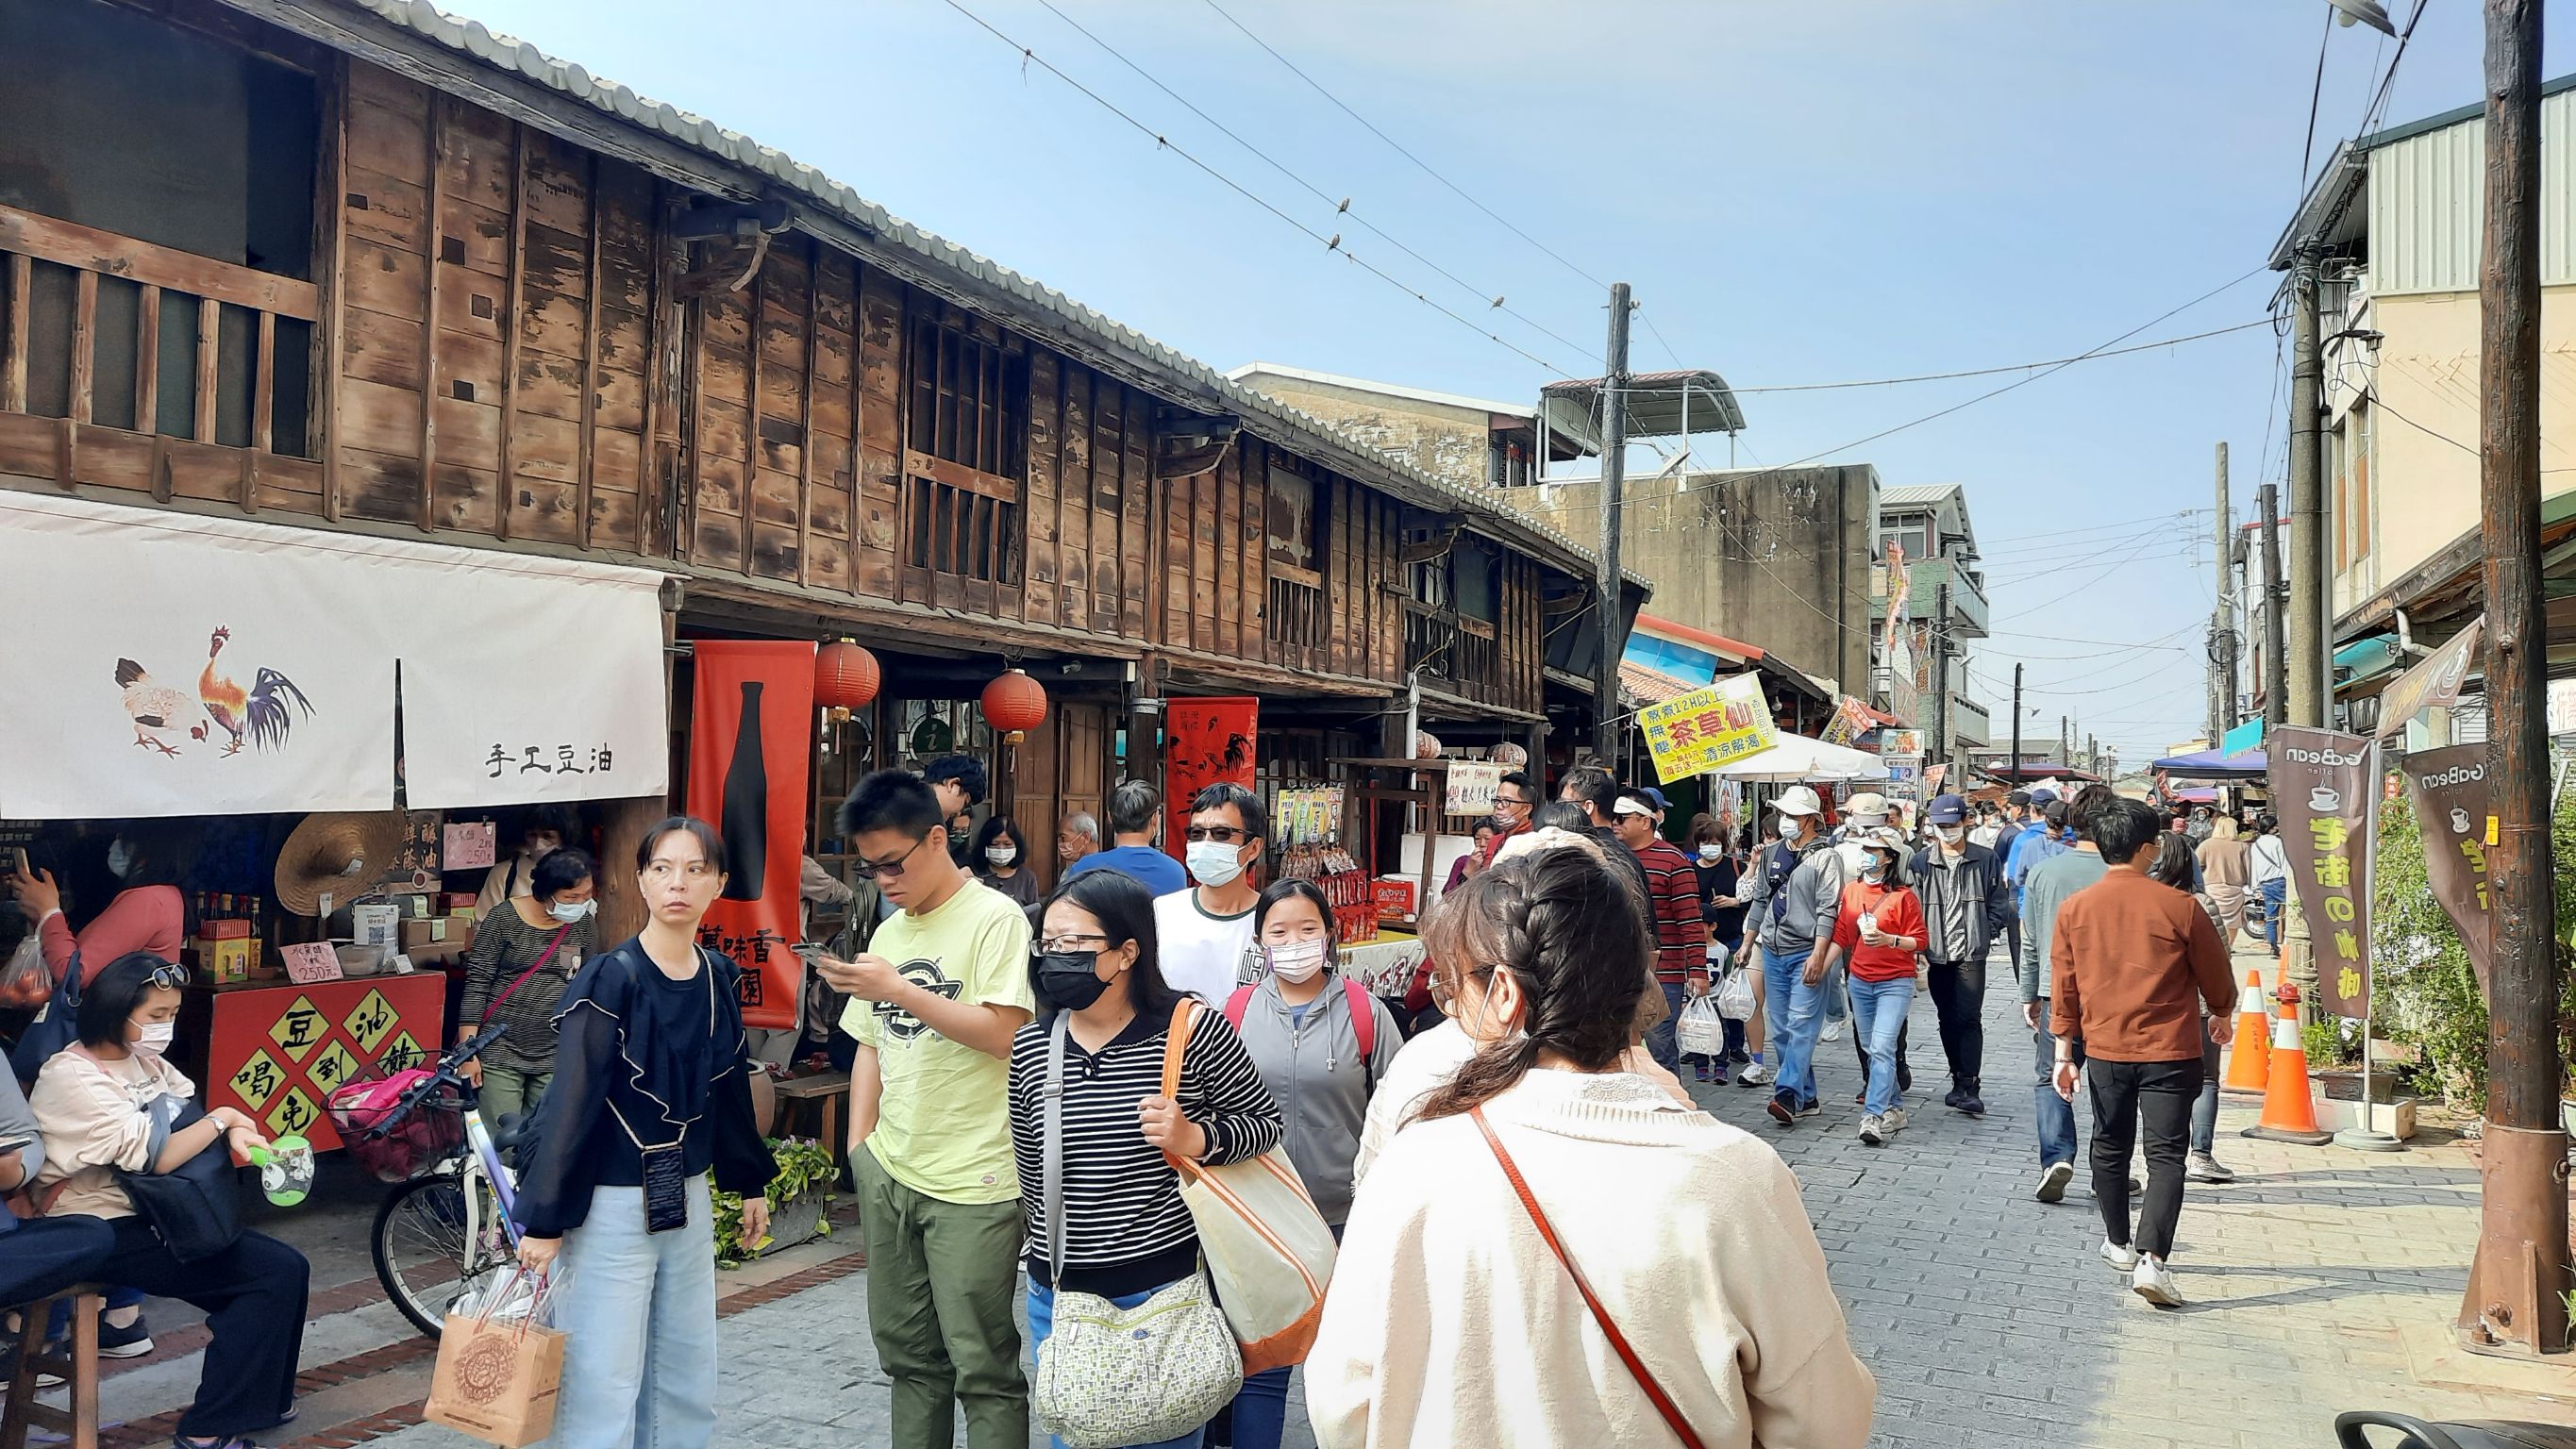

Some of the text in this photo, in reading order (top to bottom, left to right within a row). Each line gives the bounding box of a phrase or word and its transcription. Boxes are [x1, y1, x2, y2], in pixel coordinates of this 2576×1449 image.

[1648, 724, 1671, 755] 無糖
[1702, 733, 1761, 763] 清涼解渴
[485, 741, 613, 778] 手工豆油
[298, 965, 337, 980] 250元
[282, 997, 389, 1050] 豆油
